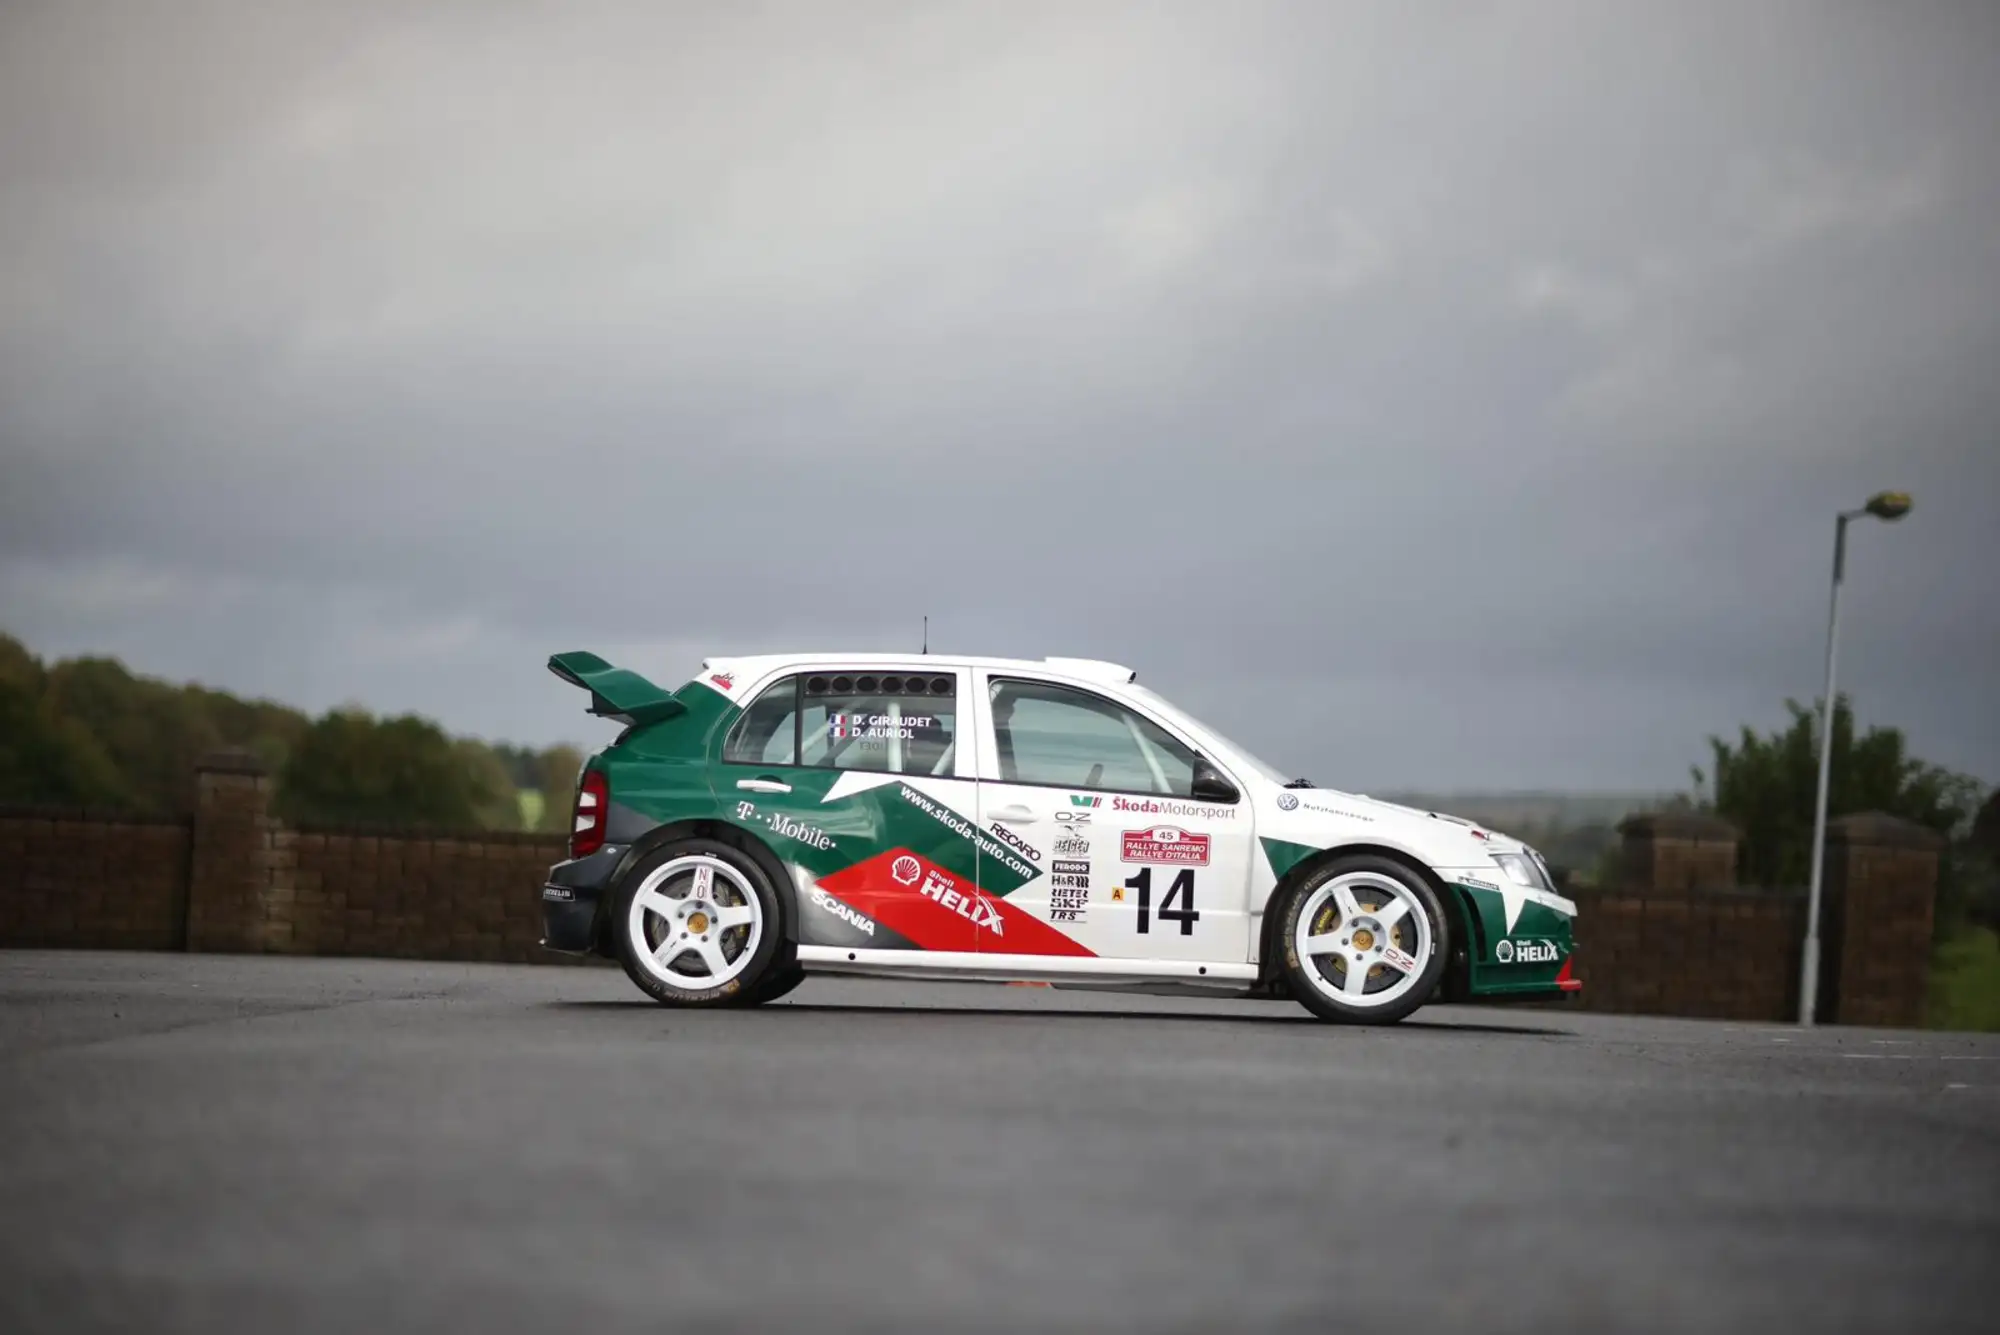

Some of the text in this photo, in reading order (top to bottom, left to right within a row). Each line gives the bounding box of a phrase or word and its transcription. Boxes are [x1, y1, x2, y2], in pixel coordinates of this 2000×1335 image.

[869, 715, 932, 727] GIRAUDET
[868, 728, 914, 739] AURIOL
[900, 786, 1034, 879] www.skoda-auto.com
[1159, 831, 1173, 841] 45
[990, 823, 1042, 862] RECARO
[1126, 842, 1205, 853] RALLYE SANREMO
[1129, 850, 1201, 860] RALLYE D'ITALIA
[1054, 862, 1087, 871] FERODO
[929, 870, 955, 887] Shell
[1051, 874, 1075, 886] H&R
[1112, 889, 1122, 900] A
[920, 876, 1004, 937] HELIX
[1050, 898, 1089, 908] SKF
[1125, 867, 1200, 936] 14
[811, 892, 875, 937] SCANIA
[1050, 910, 1077, 921] TRS
[1516, 939, 1559, 962] HELIX
